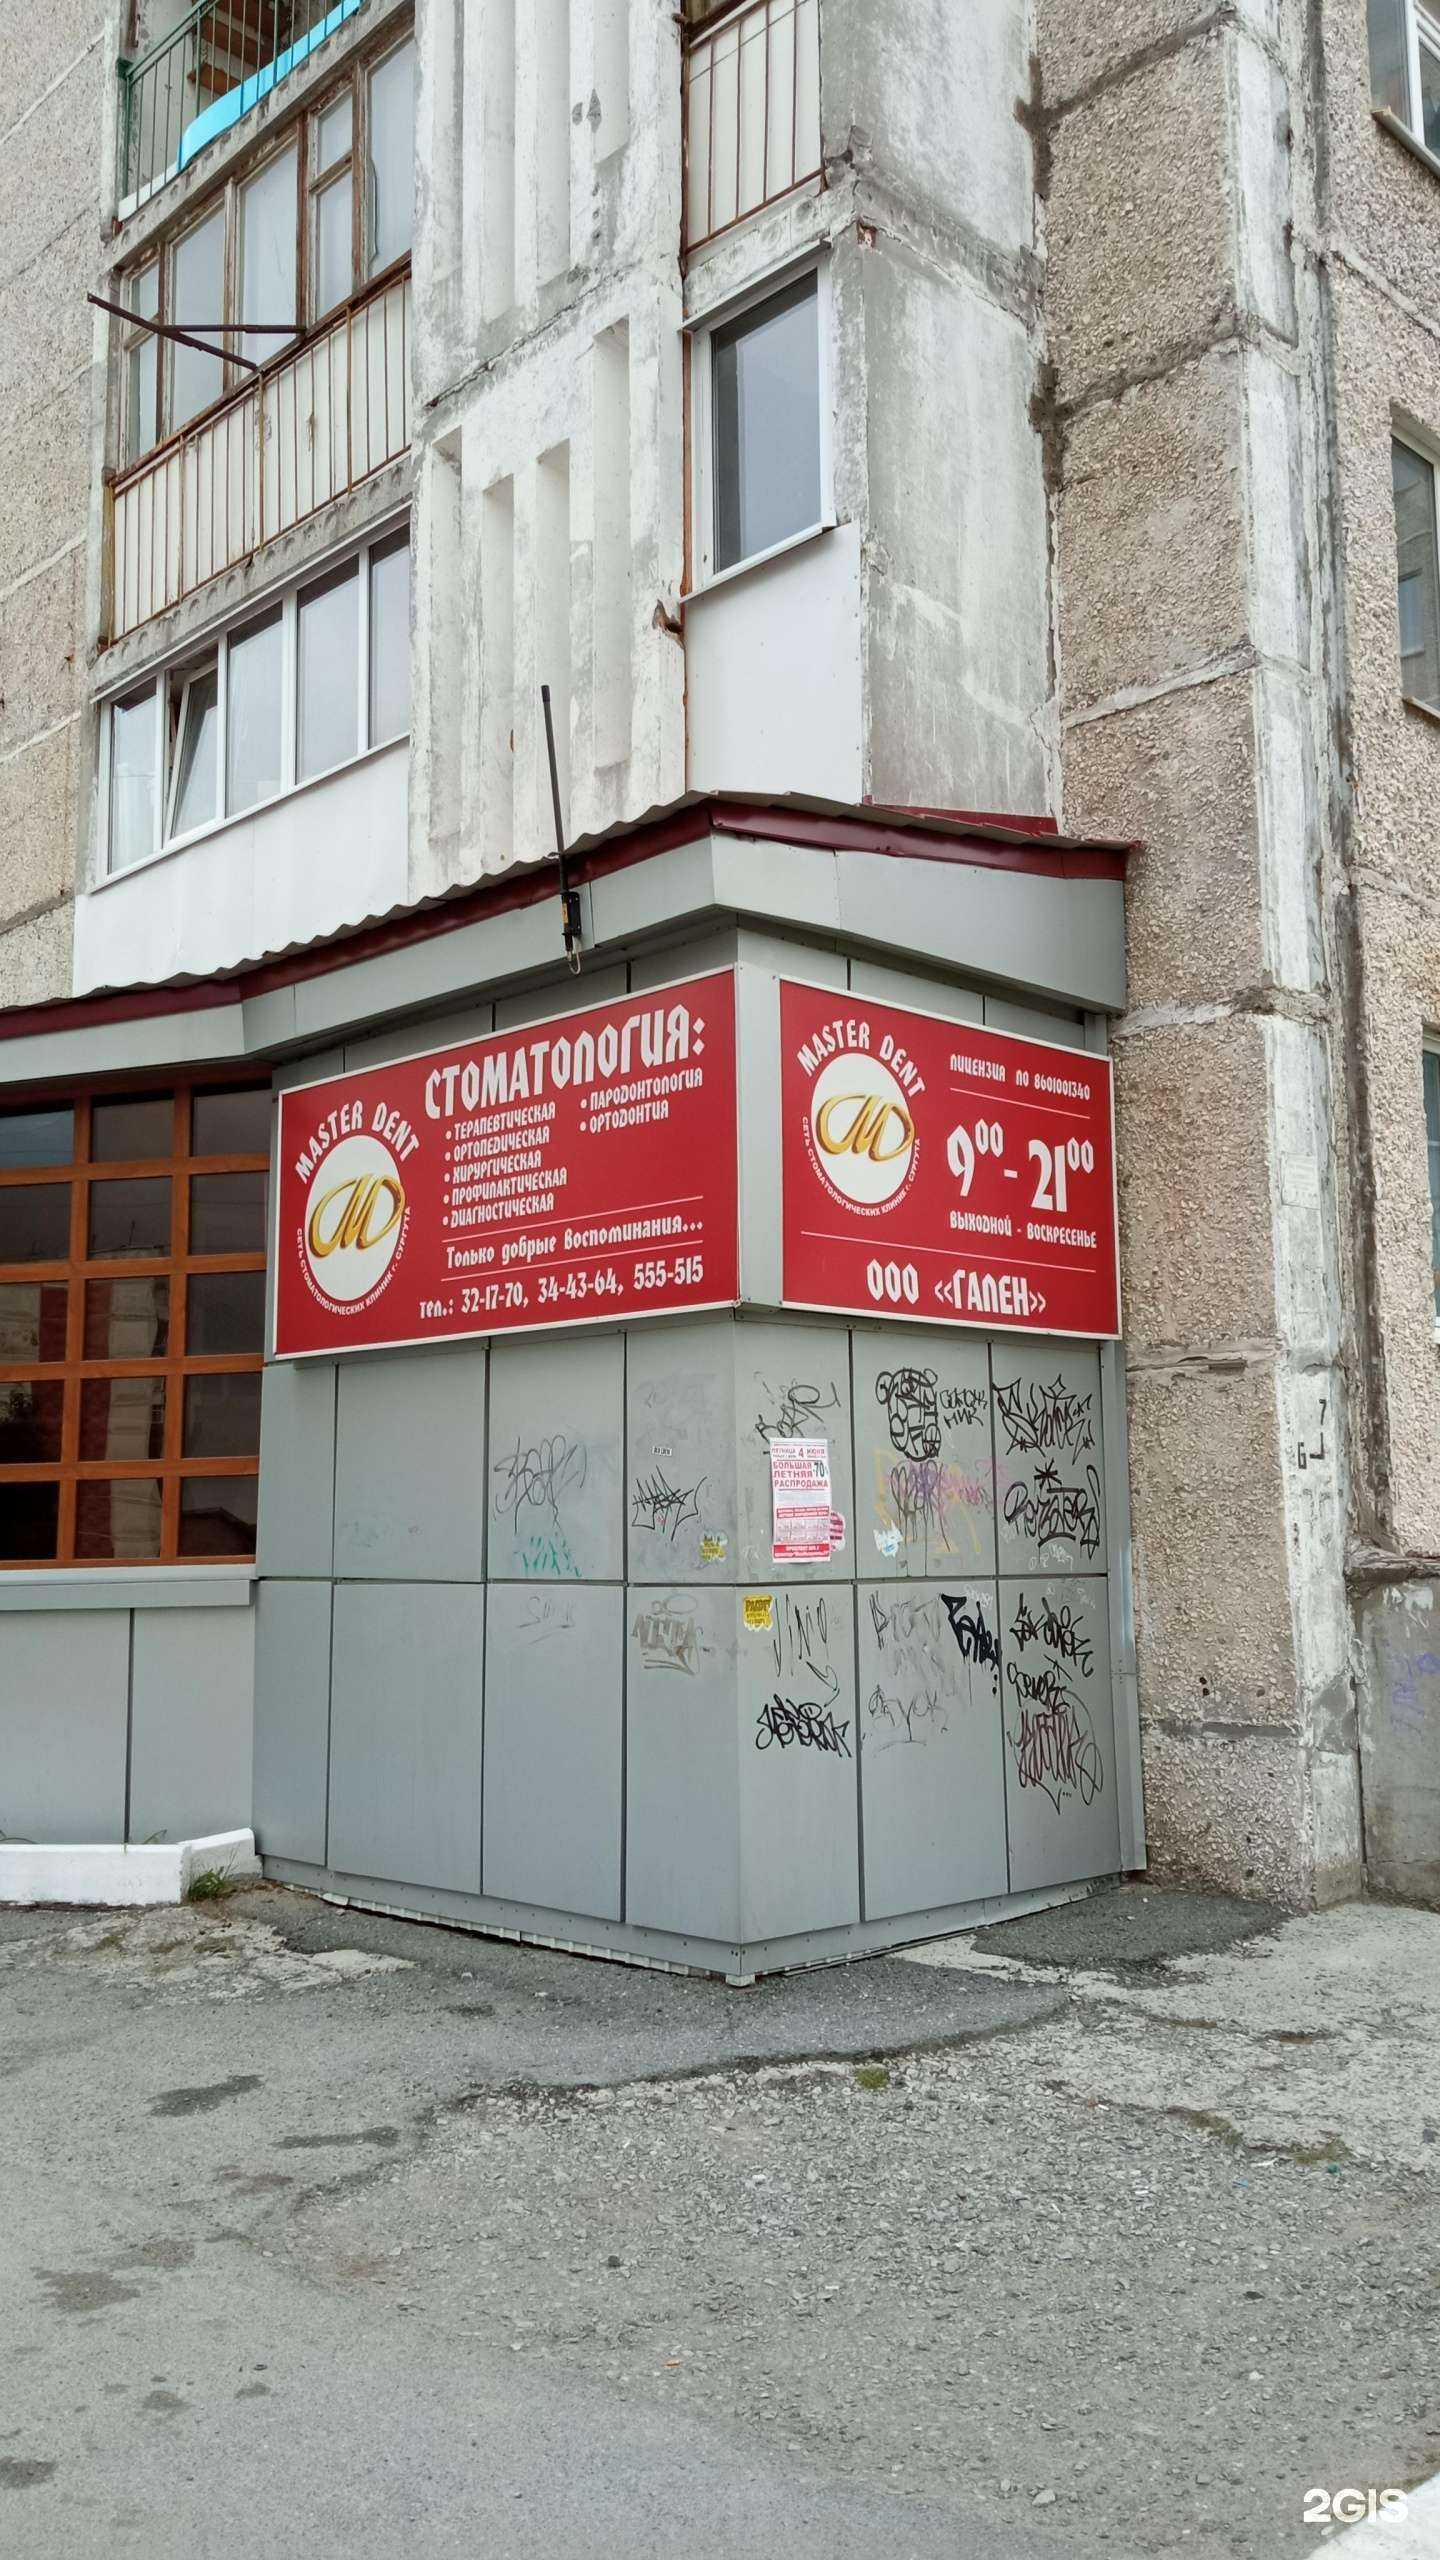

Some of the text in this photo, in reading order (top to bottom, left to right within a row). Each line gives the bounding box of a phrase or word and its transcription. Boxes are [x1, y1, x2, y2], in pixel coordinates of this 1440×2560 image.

[425, 1004, 705, 1119] СТОМАТОЛОГИЯ:
[797, 1019, 925, 1097] MASTER DENT
[950, 1053, 1006, 1082] ЛИЦЕНЗИЯ
[1034, 1073, 1090, 1101] 8601001340
[590, 1067, 703, 1111] ПАРОДОНТОЛОГИЯ
[454, 1101, 556, 1141] ТЕРАПЕВТИЧЕСКАЯ
[589, 1099, 669, 1134] ОРТОДОНТИЯ
[295, 1100, 420, 1184] MASTER DENT
[453, 1125, 550, 1162] ОРТОПЕДИЧЕСКАЯ
[451, 1166, 567, 1206] ПРОФИЛАКТИЧЕСКАЯ
[452, 1149, 541, 1184] ХИРУРГИЧЕСКАЯ
[807, 1148, 881, 1217] СТОМАТОЛОГИЧЕСКИХ
[881, 1188, 908, 1214] КЛИНИК
[908, 1139, 921, 1182] СУРГУТА
[450, 1192, 554, 1229] ДИАГНОСТИЧЕСКАЯ
[950, 1210, 1012, 1237] ВЫХОДНОЙ
[1026, 1222, 1097, 1249] ВОСКРЕСЕНЬЕ
[300, 1259, 366, 1315] СТОМАТОЛОГИЧЕСКИХ
[366, 1270, 393, 1308] КЛИНИК
[395, 1206, 411, 1260] СУРГУТА
[446, 1245, 495, 1269] Только
[501, 1235, 557, 1265] добрые
[461, 1281, 529, 1314] 32-17-70,
[537, 1267, 624, 1304] 34-43-64,
[633, 1254, 704, 1291] 555-515
[866, 1258, 920, 1304] ООО
[773, 1461, 812, 1470] БОЛЬШАЯ
[773, 1470, 813, 1479] ЛЕТНЯЯ
[774, 1480, 829, 1489] РАСПРОДАЖА
